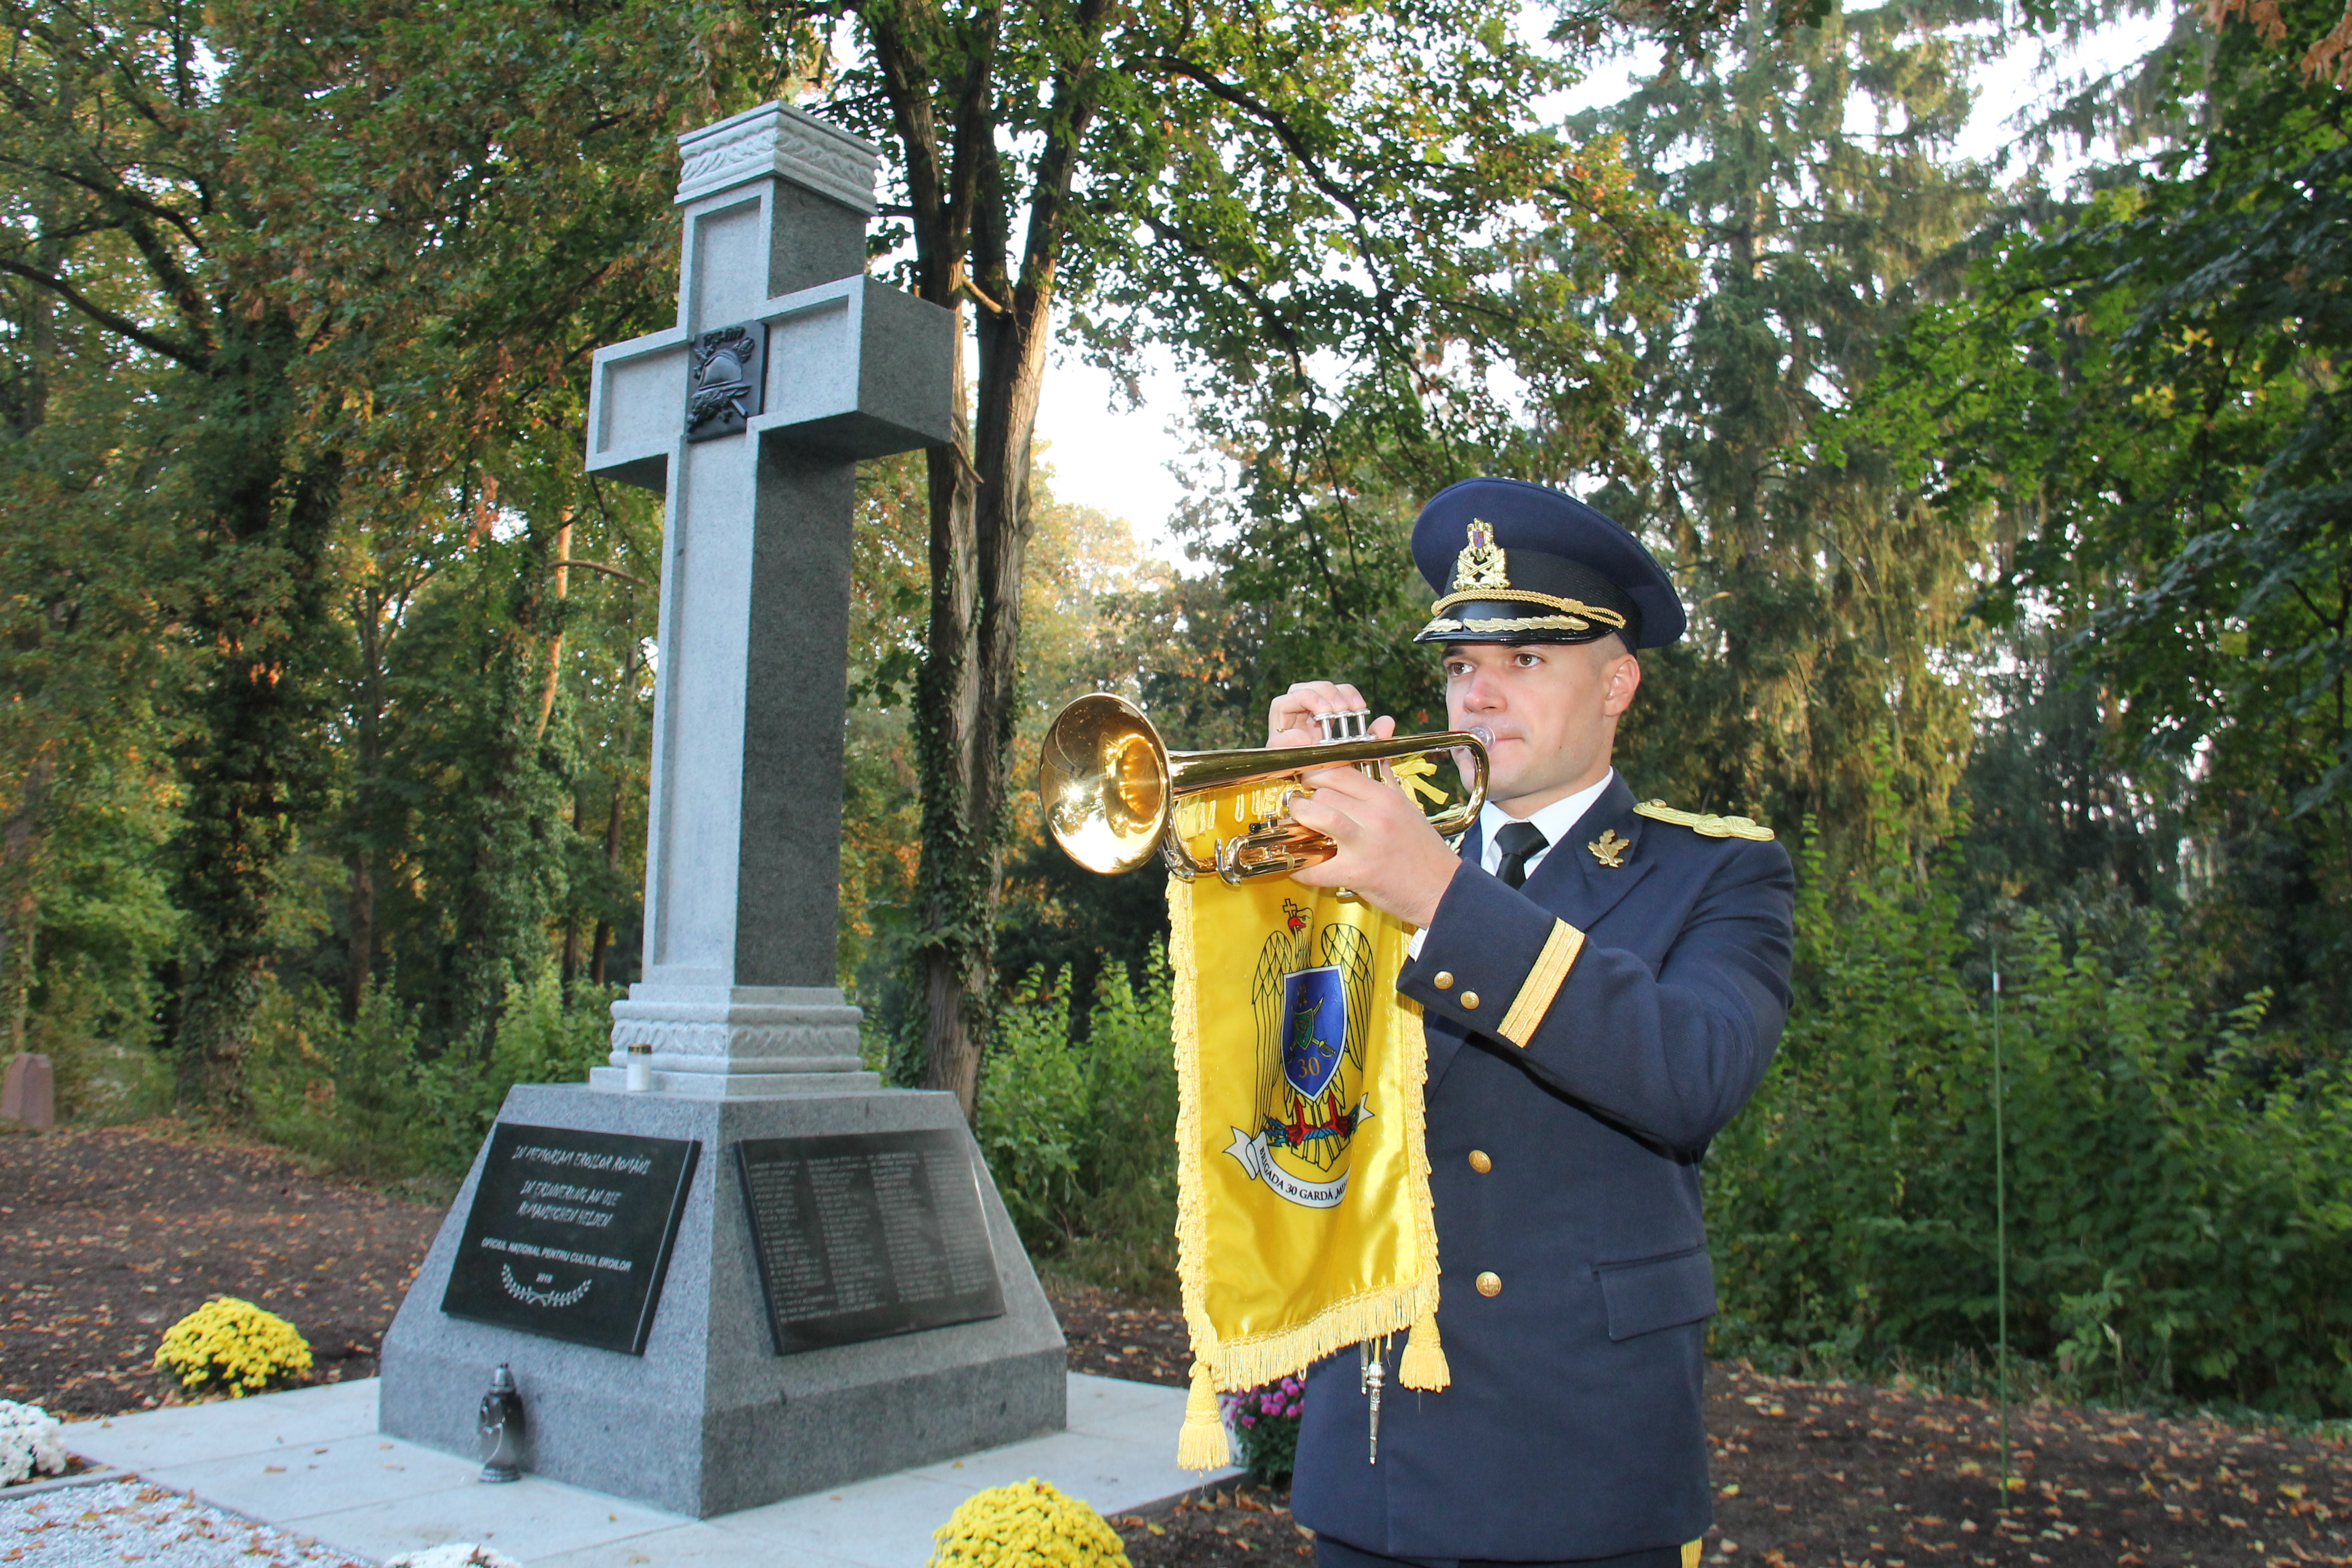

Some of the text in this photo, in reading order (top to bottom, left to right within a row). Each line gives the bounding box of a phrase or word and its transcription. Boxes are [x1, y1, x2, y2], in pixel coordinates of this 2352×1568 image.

[1298, 1057, 1320, 1077] 30
[525, 1146, 575, 1166] MEMORIAM
[574, 1151, 613, 1171] EROILOR
[1259, 1146, 1283, 1190] BRIGADA
[1286, 1183, 1298, 1195] 30
[520, 1180, 623, 1207] IN ERINNERUNG AN DIE
[575, 1208, 614, 1228] HELDEN
[481, 1237, 508, 1251] OFICIUL
[541, 1246, 570, 1261] PENTRU
[569, 1252, 597, 1266] CULTUL
[597, 1256, 633, 1272] EROILOR
